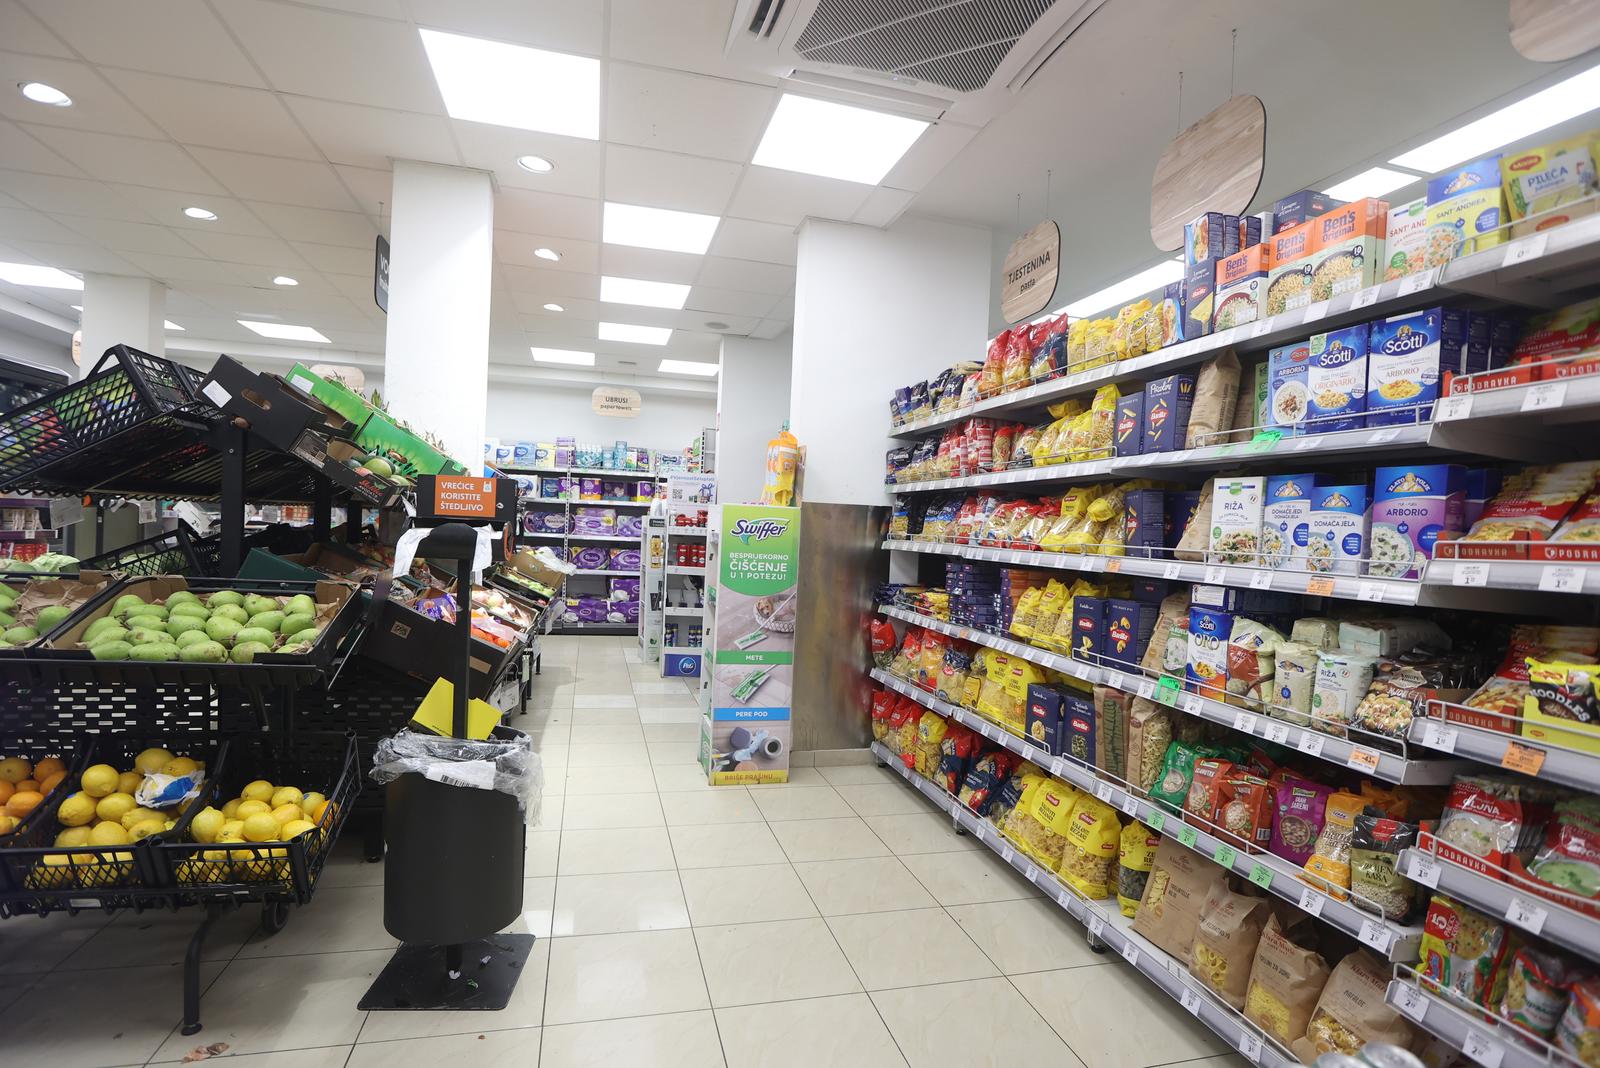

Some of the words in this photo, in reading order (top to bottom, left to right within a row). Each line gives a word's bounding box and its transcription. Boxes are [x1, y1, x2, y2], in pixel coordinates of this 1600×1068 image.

[1322, 209, 1356, 234] Ben's
[1276, 229, 1306, 250] Ben's
[1322, 223, 1356, 243] Original
[1276, 244, 1305, 261] Original
[1008, 250, 1051, 285] TJESTENINA
[1225, 254, 1248, 272] Ben's
[1020, 278, 1036, 294] pasta
[1385, 334, 1424, 352] Scotti
[1319, 348, 1351, 367] Scotti
[1278, 365, 1306, 377] ARBORIO
[1386, 367, 1420, 378] ARBORIO
[441, 481, 475, 491] VREĆICE
[440, 492, 481, 501] KORISTITE
[440, 501, 484, 512] ŠTEDLJIVO
[1223, 501, 1244, 511] RIŽA
[1386, 507, 1429, 517] ARBORIO
[731, 518, 786, 541] Swiffer
[1314, 519, 1341, 528] DOMAĆA
[1340, 520, 1356, 528] JELA
[729, 551, 789, 561] BESPRIJEKORNO
[1460, 548, 1508, 557] ODRAVKA
[729, 559, 788, 572] ČIŠĆENJE
[730, 571, 736, 579] U
[746, 572, 786, 581] POTEZU!
[1194, 632, 1220, 651] ORO
[745, 654, 764, 662] METE
[1320, 669, 1337, 679] RIŽA
[1529, 687, 1591, 722] NOODLES
[1438, 846, 1488, 874] PODRAVKA
